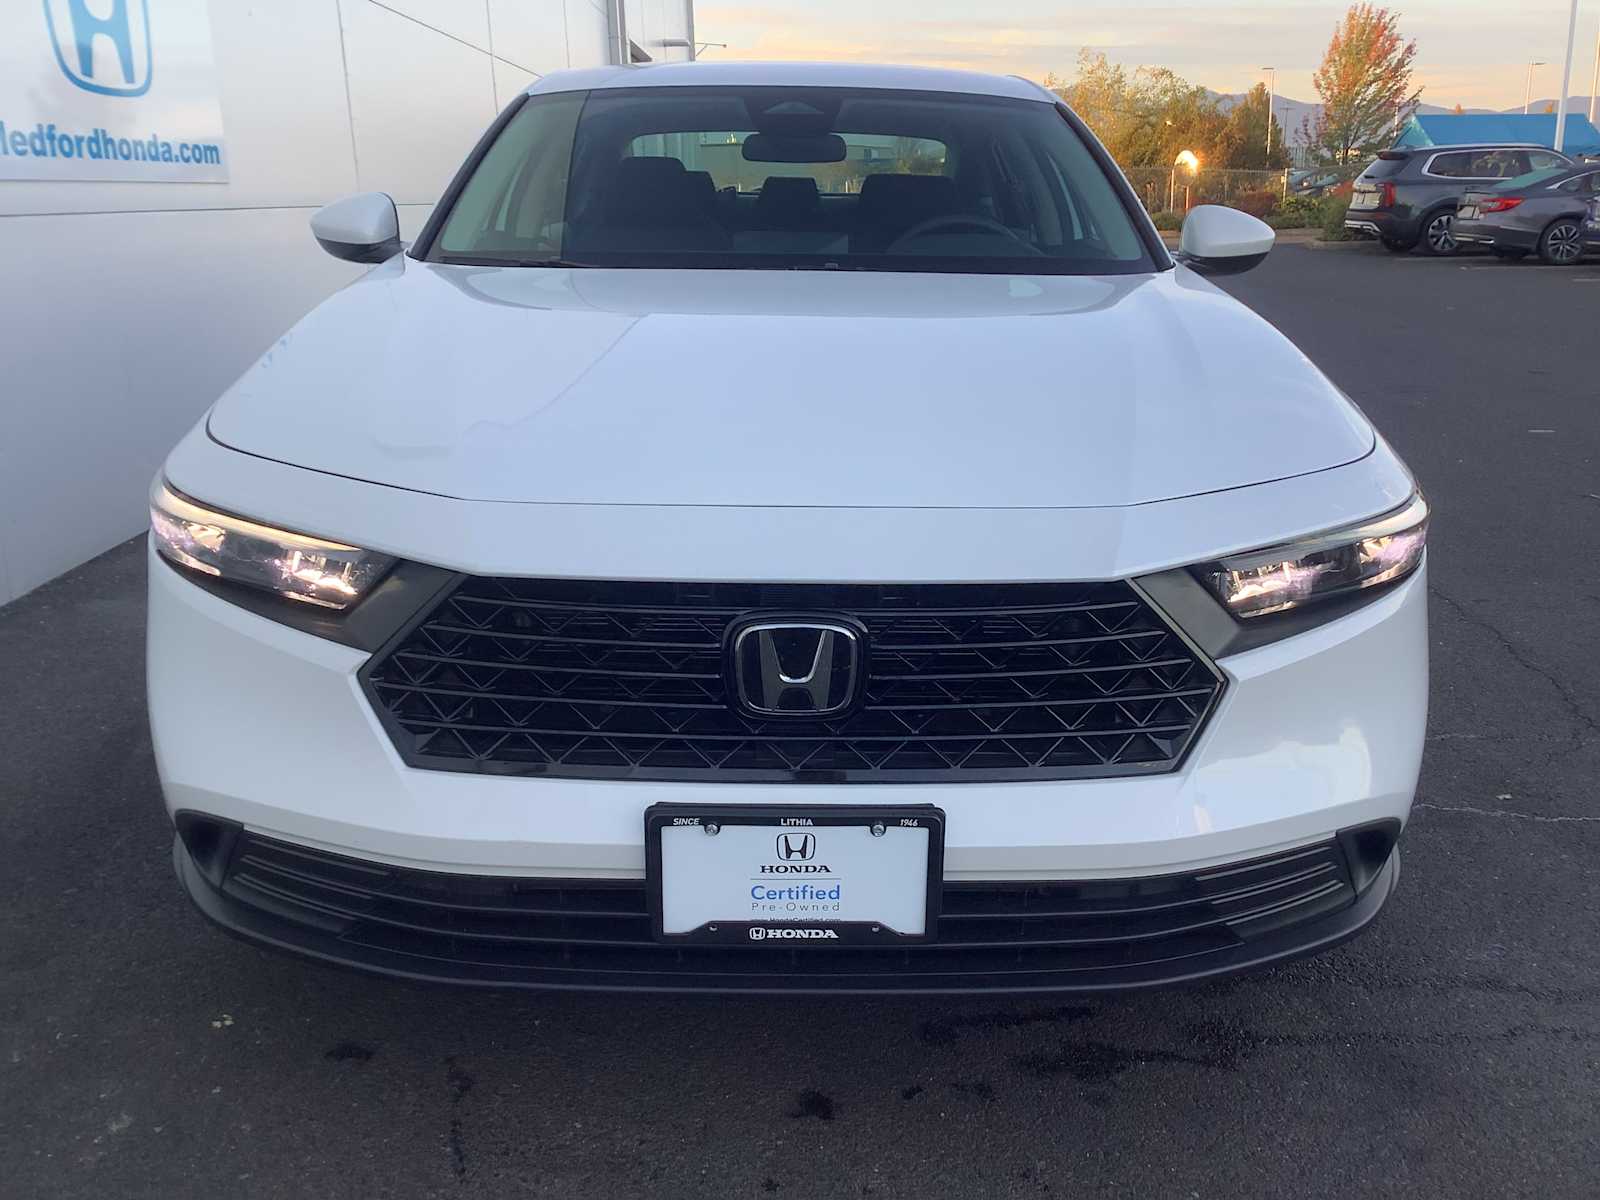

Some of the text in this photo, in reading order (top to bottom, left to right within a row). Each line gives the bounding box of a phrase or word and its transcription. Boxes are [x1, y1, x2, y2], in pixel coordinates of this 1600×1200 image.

[673, 817, 918, 827] SINCE LITHIA 1946
[760, 865, 831, 873] HONDA
[751, 884, 840, 900] Certified
[751, 902, 840, 911] Pre-Owned
[766, 929, 839, 939] HONDA
